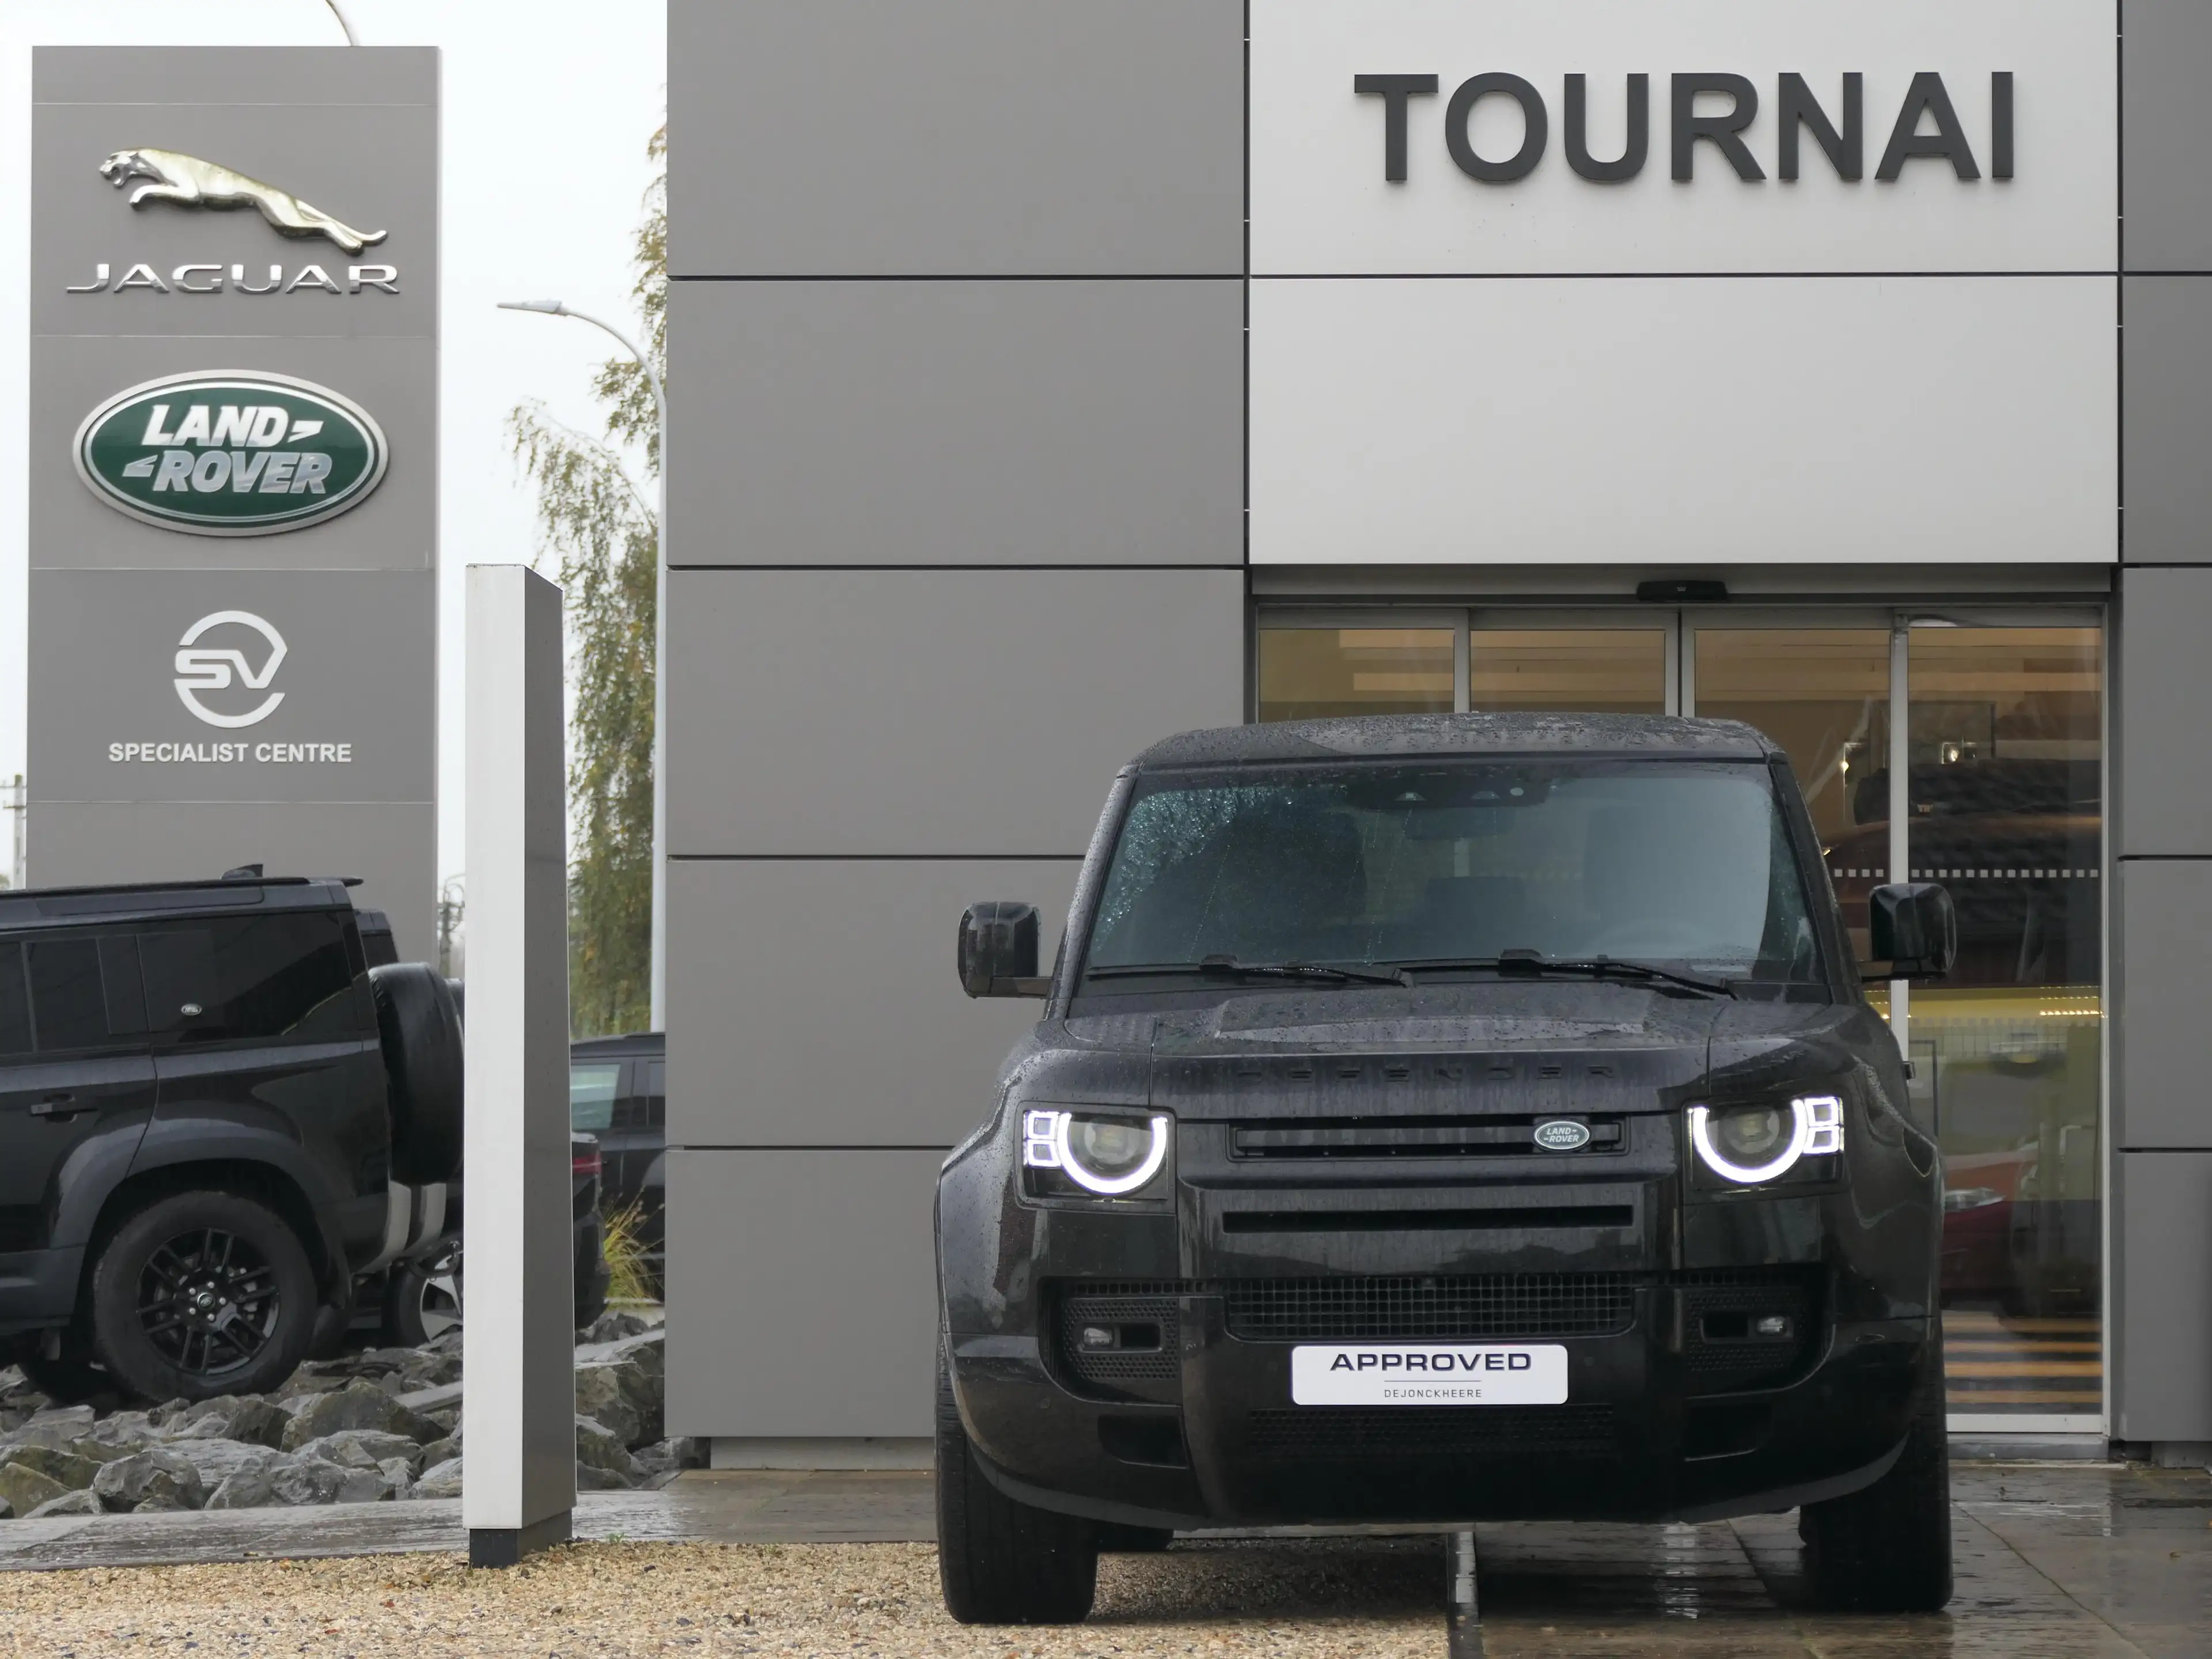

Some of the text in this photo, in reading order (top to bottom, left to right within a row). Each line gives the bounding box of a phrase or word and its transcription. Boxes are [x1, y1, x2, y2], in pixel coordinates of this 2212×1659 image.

[1354, 71, 2014, 182] TOURNAI
[66, 264, 400, 294] JAGUAR
[108, 743, 352, 763] SPECIALIST CENTRE
[1330, 1353, 1532, 1372] APPROVED
[1384, 1389, 1482, 1398] DEJONCKHEERE
